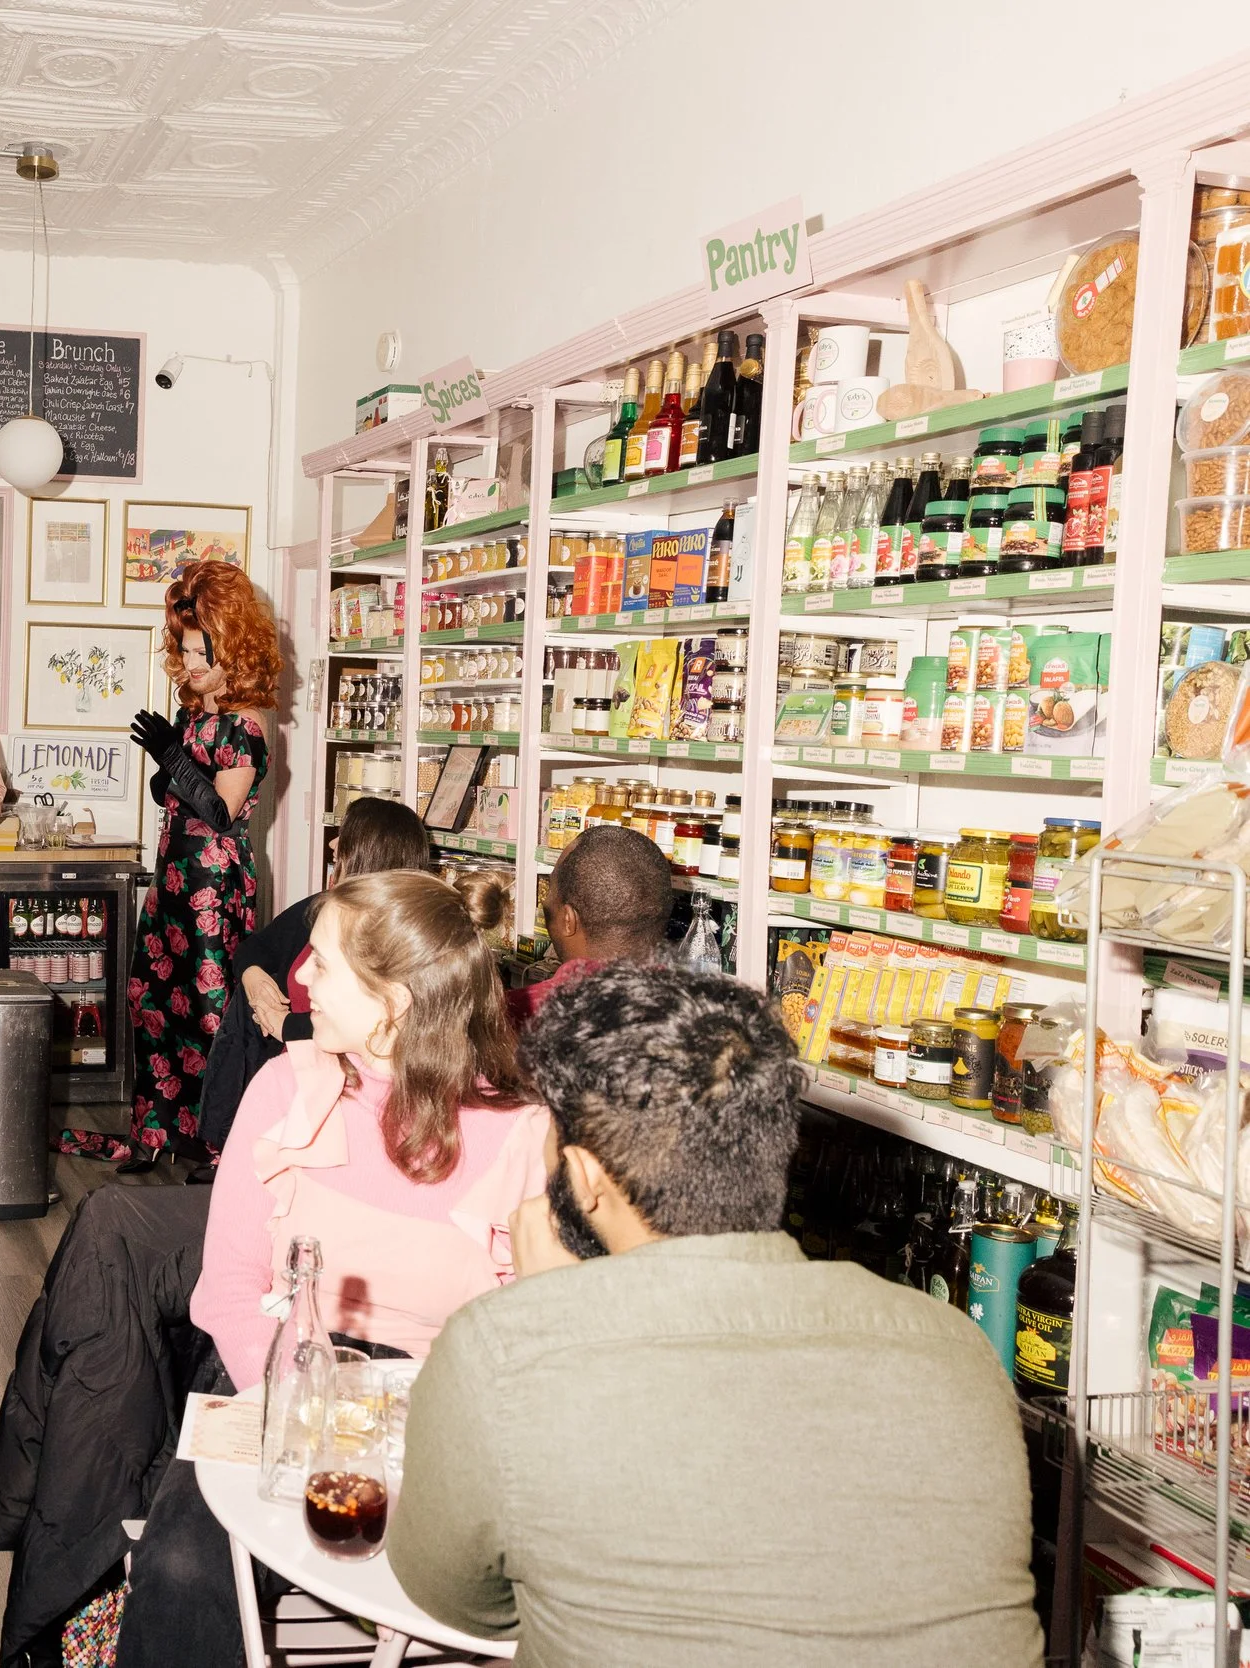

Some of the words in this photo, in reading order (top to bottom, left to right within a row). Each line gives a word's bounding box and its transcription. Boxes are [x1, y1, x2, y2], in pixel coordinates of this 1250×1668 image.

[706, 223, 799, 291] Pantry
[51, 338, 115, 362] Brunch
[44, 373, 69, 385] Baked
[99, 378, 113, 390] Egg
[118, 378, 131, 387] $5
[66, 386, 100, 399] Overnight
[120, 389, 131, 399] $6
[423, 374, 481, 423] Spices
[91, 412, 101, 422] $7
[81, 441, 95, 451] Egg
[652, 541, 679, 559] PARO
[679, 533, 706, 553] PARO
[1043, 675, 1065, 683] FALAFEL
[18, 744, 121, 782] LEMONADE
[850, 942, 867, 951] MUTTI
[874, 942, 889, 950] MUTTI
[1019, 1314, 1036, 1327] OLIVE
[1037, 1322, 1052, 1333] OIL
[1032, 1312, 1063, 1328] VIRGIN
